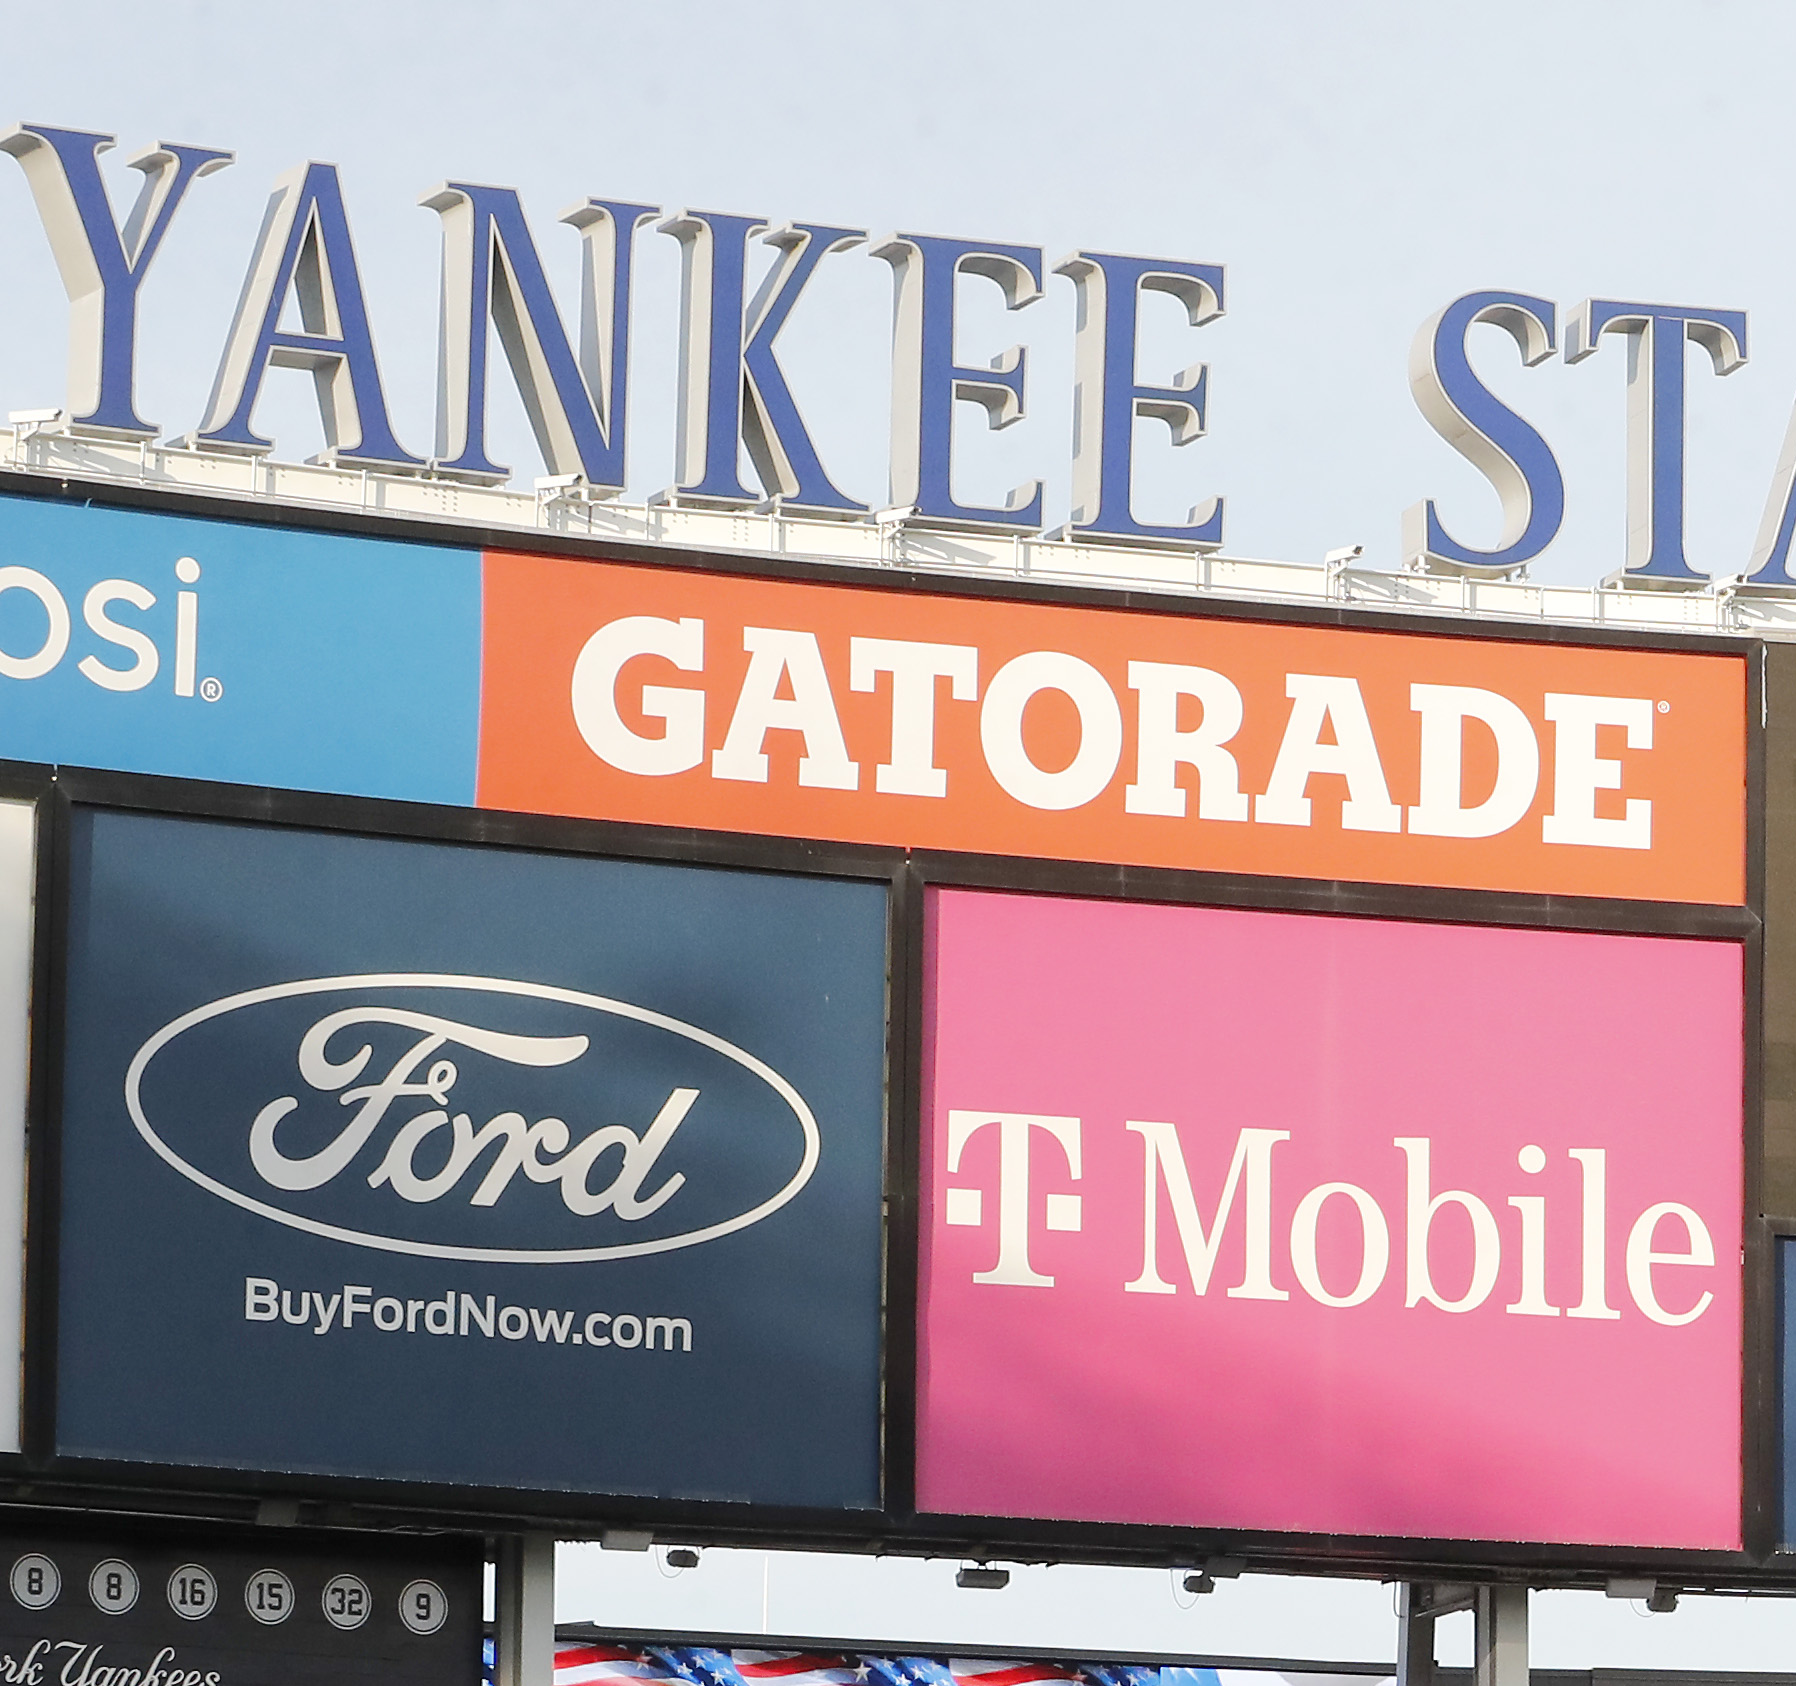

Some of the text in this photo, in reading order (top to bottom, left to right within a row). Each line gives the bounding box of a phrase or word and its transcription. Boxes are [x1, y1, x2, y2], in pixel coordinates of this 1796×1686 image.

[0, 121, 1227, 552] YANKEE
[570, 615, 1655, 850] GATORADE
[249, 1006, 701, 1222] Ford
[1124, 1119, 1717, 1327] Mobile
[244, 1277, 694, 1351] BuyFordNow.com
[27, 1567, 44, 1596] 8
[106, 1572, 123, 1601] 8
[179, 1577, 206, 1606] 16
[256, 1582, 284, 1611] 15
[330, 1587, 363, 1616] 32
[415, 1593, 432, 1621] 9
[0, 1639, 51, 1686] rk
